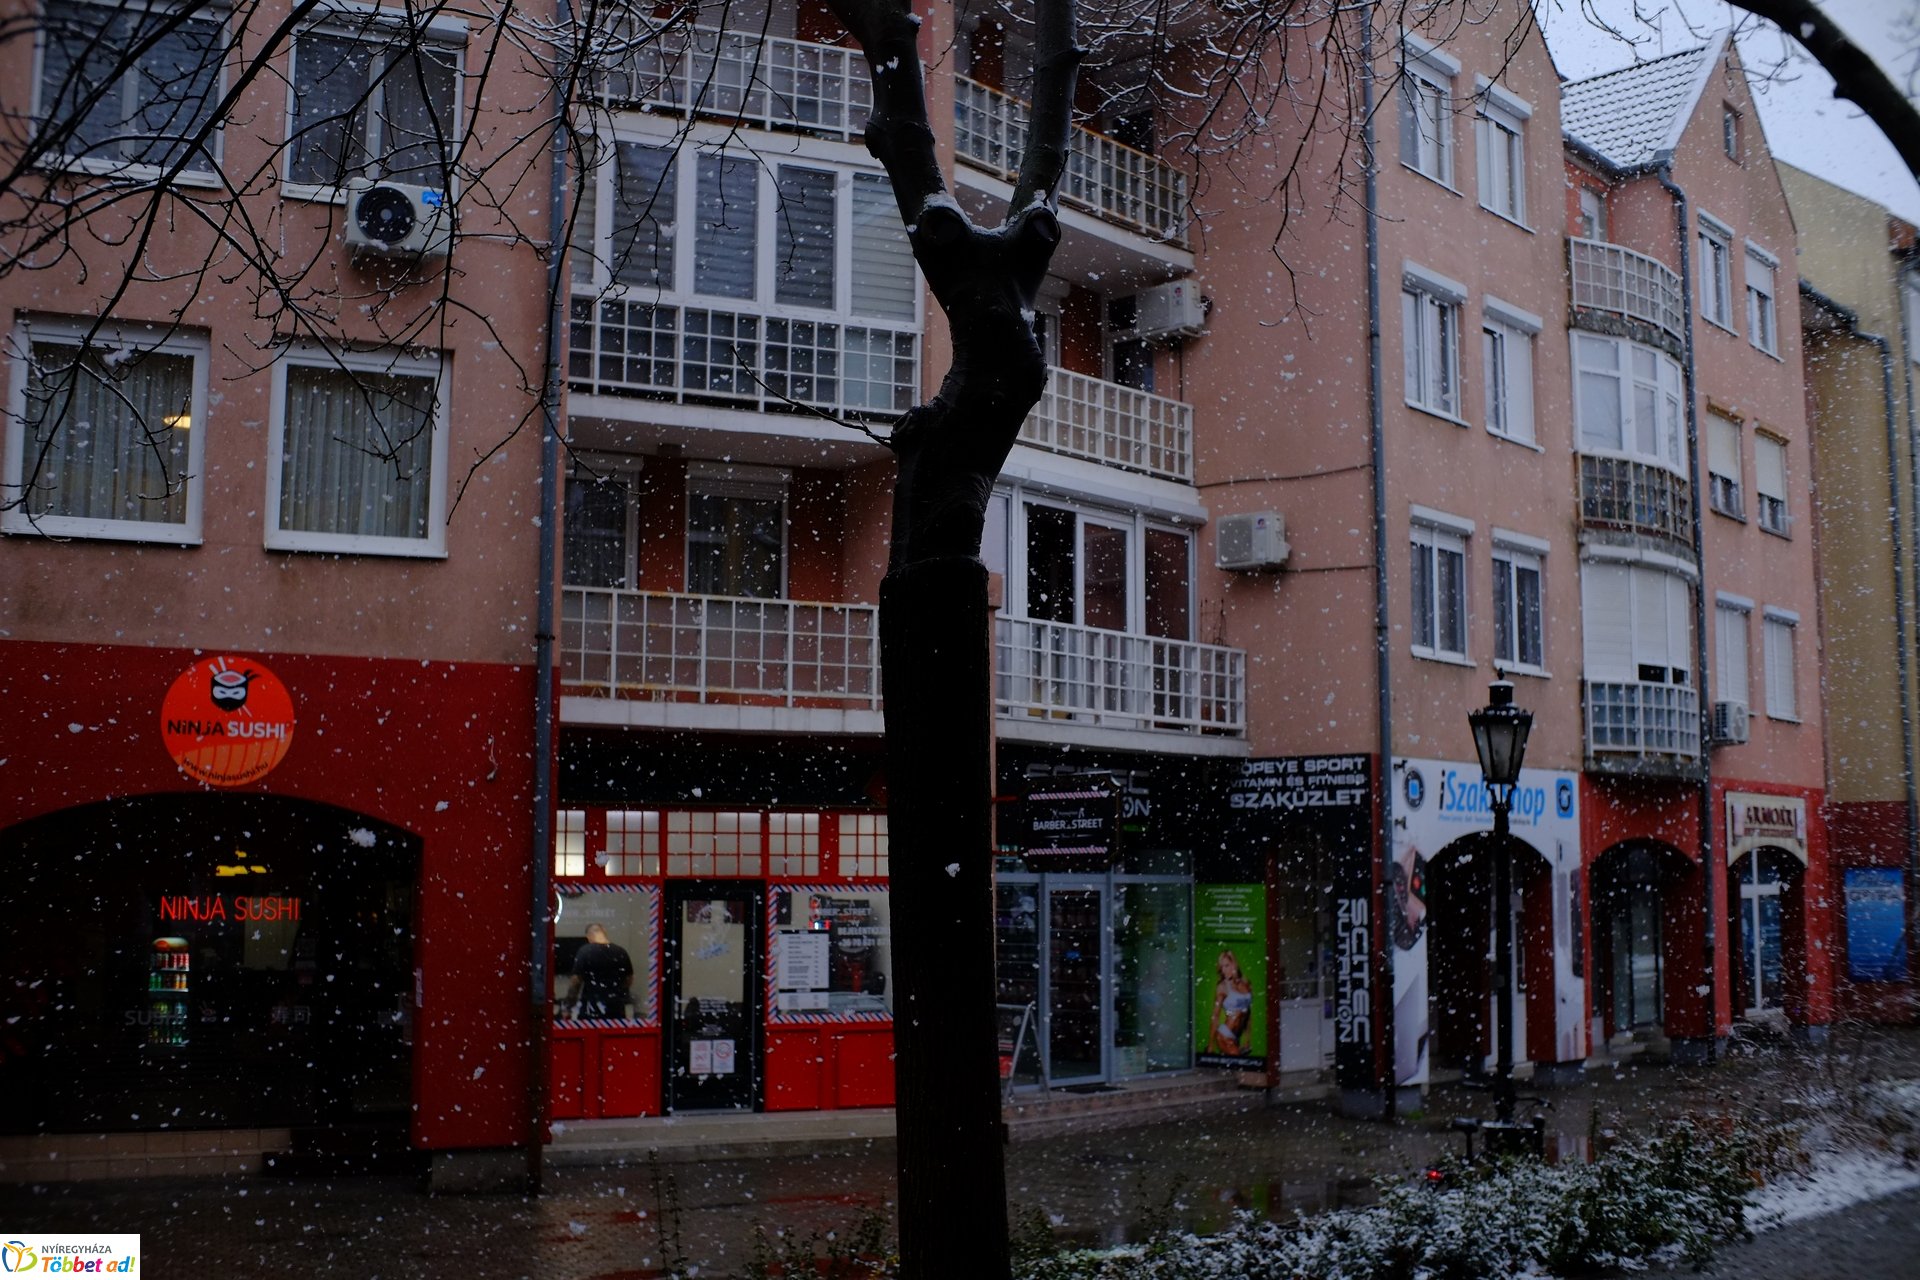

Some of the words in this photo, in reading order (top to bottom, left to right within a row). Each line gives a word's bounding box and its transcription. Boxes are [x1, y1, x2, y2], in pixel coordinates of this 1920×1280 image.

[227, 721, 286, 738] SUSHI
[183, 757, 269, 782] www.ninjasushi.hu
[1304, 757, 1365, 772] SPORT
[1230, 775, 1283, 788] VITAMIN
[1286, 773, 1305, 787] ÉS
[1308, 773, 1367, 786] FITNESS
[1230, 787, 1366, 809] SZAKÜZLET
[1033, 820, 1067, 831] BARBER
[1072, 818, 1104, 830] STREET
[160, 896, 227, 921] NINJA
[234, 896, 300, 921] SUSHI
[1337, 898, 1352, 1044] NUTRITION
[1351, 898, 1371, 1044] SCITEC
